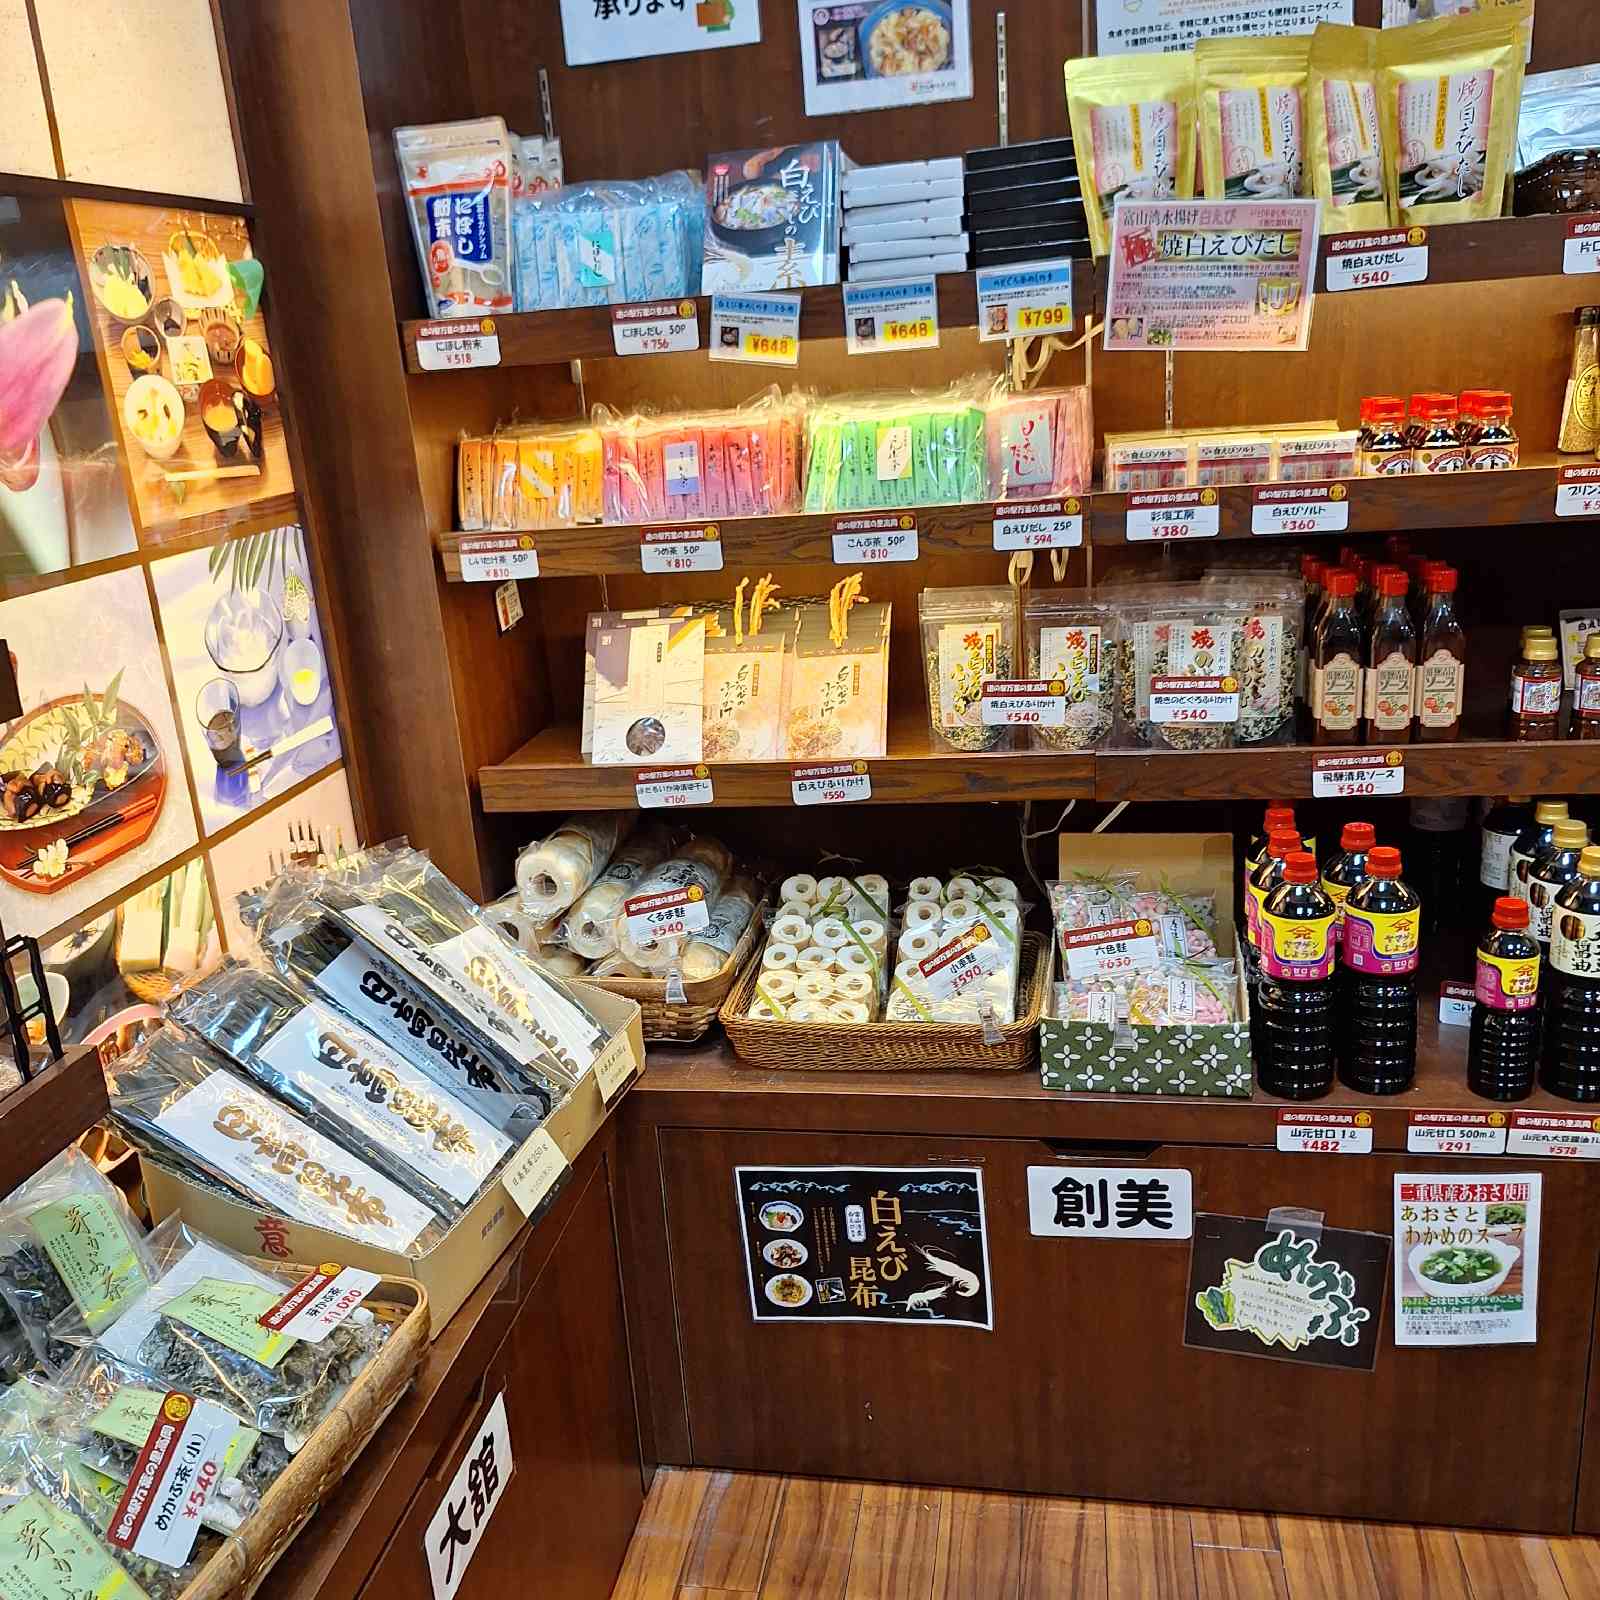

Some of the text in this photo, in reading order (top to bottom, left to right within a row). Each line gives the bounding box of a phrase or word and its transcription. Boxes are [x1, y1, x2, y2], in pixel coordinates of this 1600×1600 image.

[1162, 232, 1298, 258] 焼白えびだし
[1341, 254, 1405, 271] 焼白えびだし
[1352, 270, 1389, 284] ¥540
[1024, 308, 1064, 325] ¥799
[890, 322, 928, 339] ¥648
[752, 337, 788, 355] ¥648
[446, 352, 472, 365] ¥518
[1212, 445, 1257, 457] 白えびソルト
[1293, 440, 1338, 452] 白えびソルト
[1130, 449, 1173, 460] 白えびソルト
[1150, 509, 1195, 521] 彩塩工房
[1271, 506, 1327, 518] 白えびソルト
[1002, 520, 1072, 535] 白えびだし 25P
[1152, 525, 1189, 537] ¥380
[1281, 519, 1316, 531] ¥360
[847, 535, 905, 548] こんぶ茶 50P
[653, 544, 701, 556] うめ茶 50P
[862, 547, 889, 560] ¥810
[666, 557, 692, 569] ¥810
[485, 567, 510, 578] ¥810
[1327, 680, 1355, 689] ソース
[1380, 680, 1409, 689] ソース
[1426, 678, 1456, 687] ソース
[990, 700, 1056, 709] 焼白えびふりかけ
[1007, 712, 1040, 722] ¥540
[1172, 709, 1208, 720] ¥540
[1322, 769, 1395, 783] 飛騨清見ソース
[798, 777, 864, 792] 白えびふりかけ
[1338, 783, 1374, 795] ¥540
[823, 790, 846, 800] ¥550
[647, 907, 686, 923] くるま麩
[651, 921, 684, 936] ¥540
[1093, 942, 1129, 956] 六色麩
[950, 963, 983, 988] ¥590
[359, 969, 502, 1093] 日高昆布
[313, 1031, 477, 1155] 日高昆布
[1290, 1129, 1337, 1140] 山元甘口
[1414, 1128, 1456, 1139] 山元甘口
[1302, 1140, 1340, 1152] ¥482
[1438, 1141, 1471, 1152] ¥291
[1548, 1145, 1578, 1155] ¥578
[212, 1104, 393, 1228] 日高昆布
[1401, 1183, 1530, 1201] 三重県産あおさ使用
[1051, 1176, 1174, 1230] 創美
[1400, 1204, 1479, 1223] あおさと
[870, 1189, 908, 1281] 白えび
[849, 1256, 880, 1310] 昆布
[305, 1285, 344, 1318] 芽かぶ茶
[115, 1423, 176, 1541] 道の駅万葉の里高岡
[183, 1460, 217, 1520] ¥540
[439, 1431, 499, 1586] 大館
